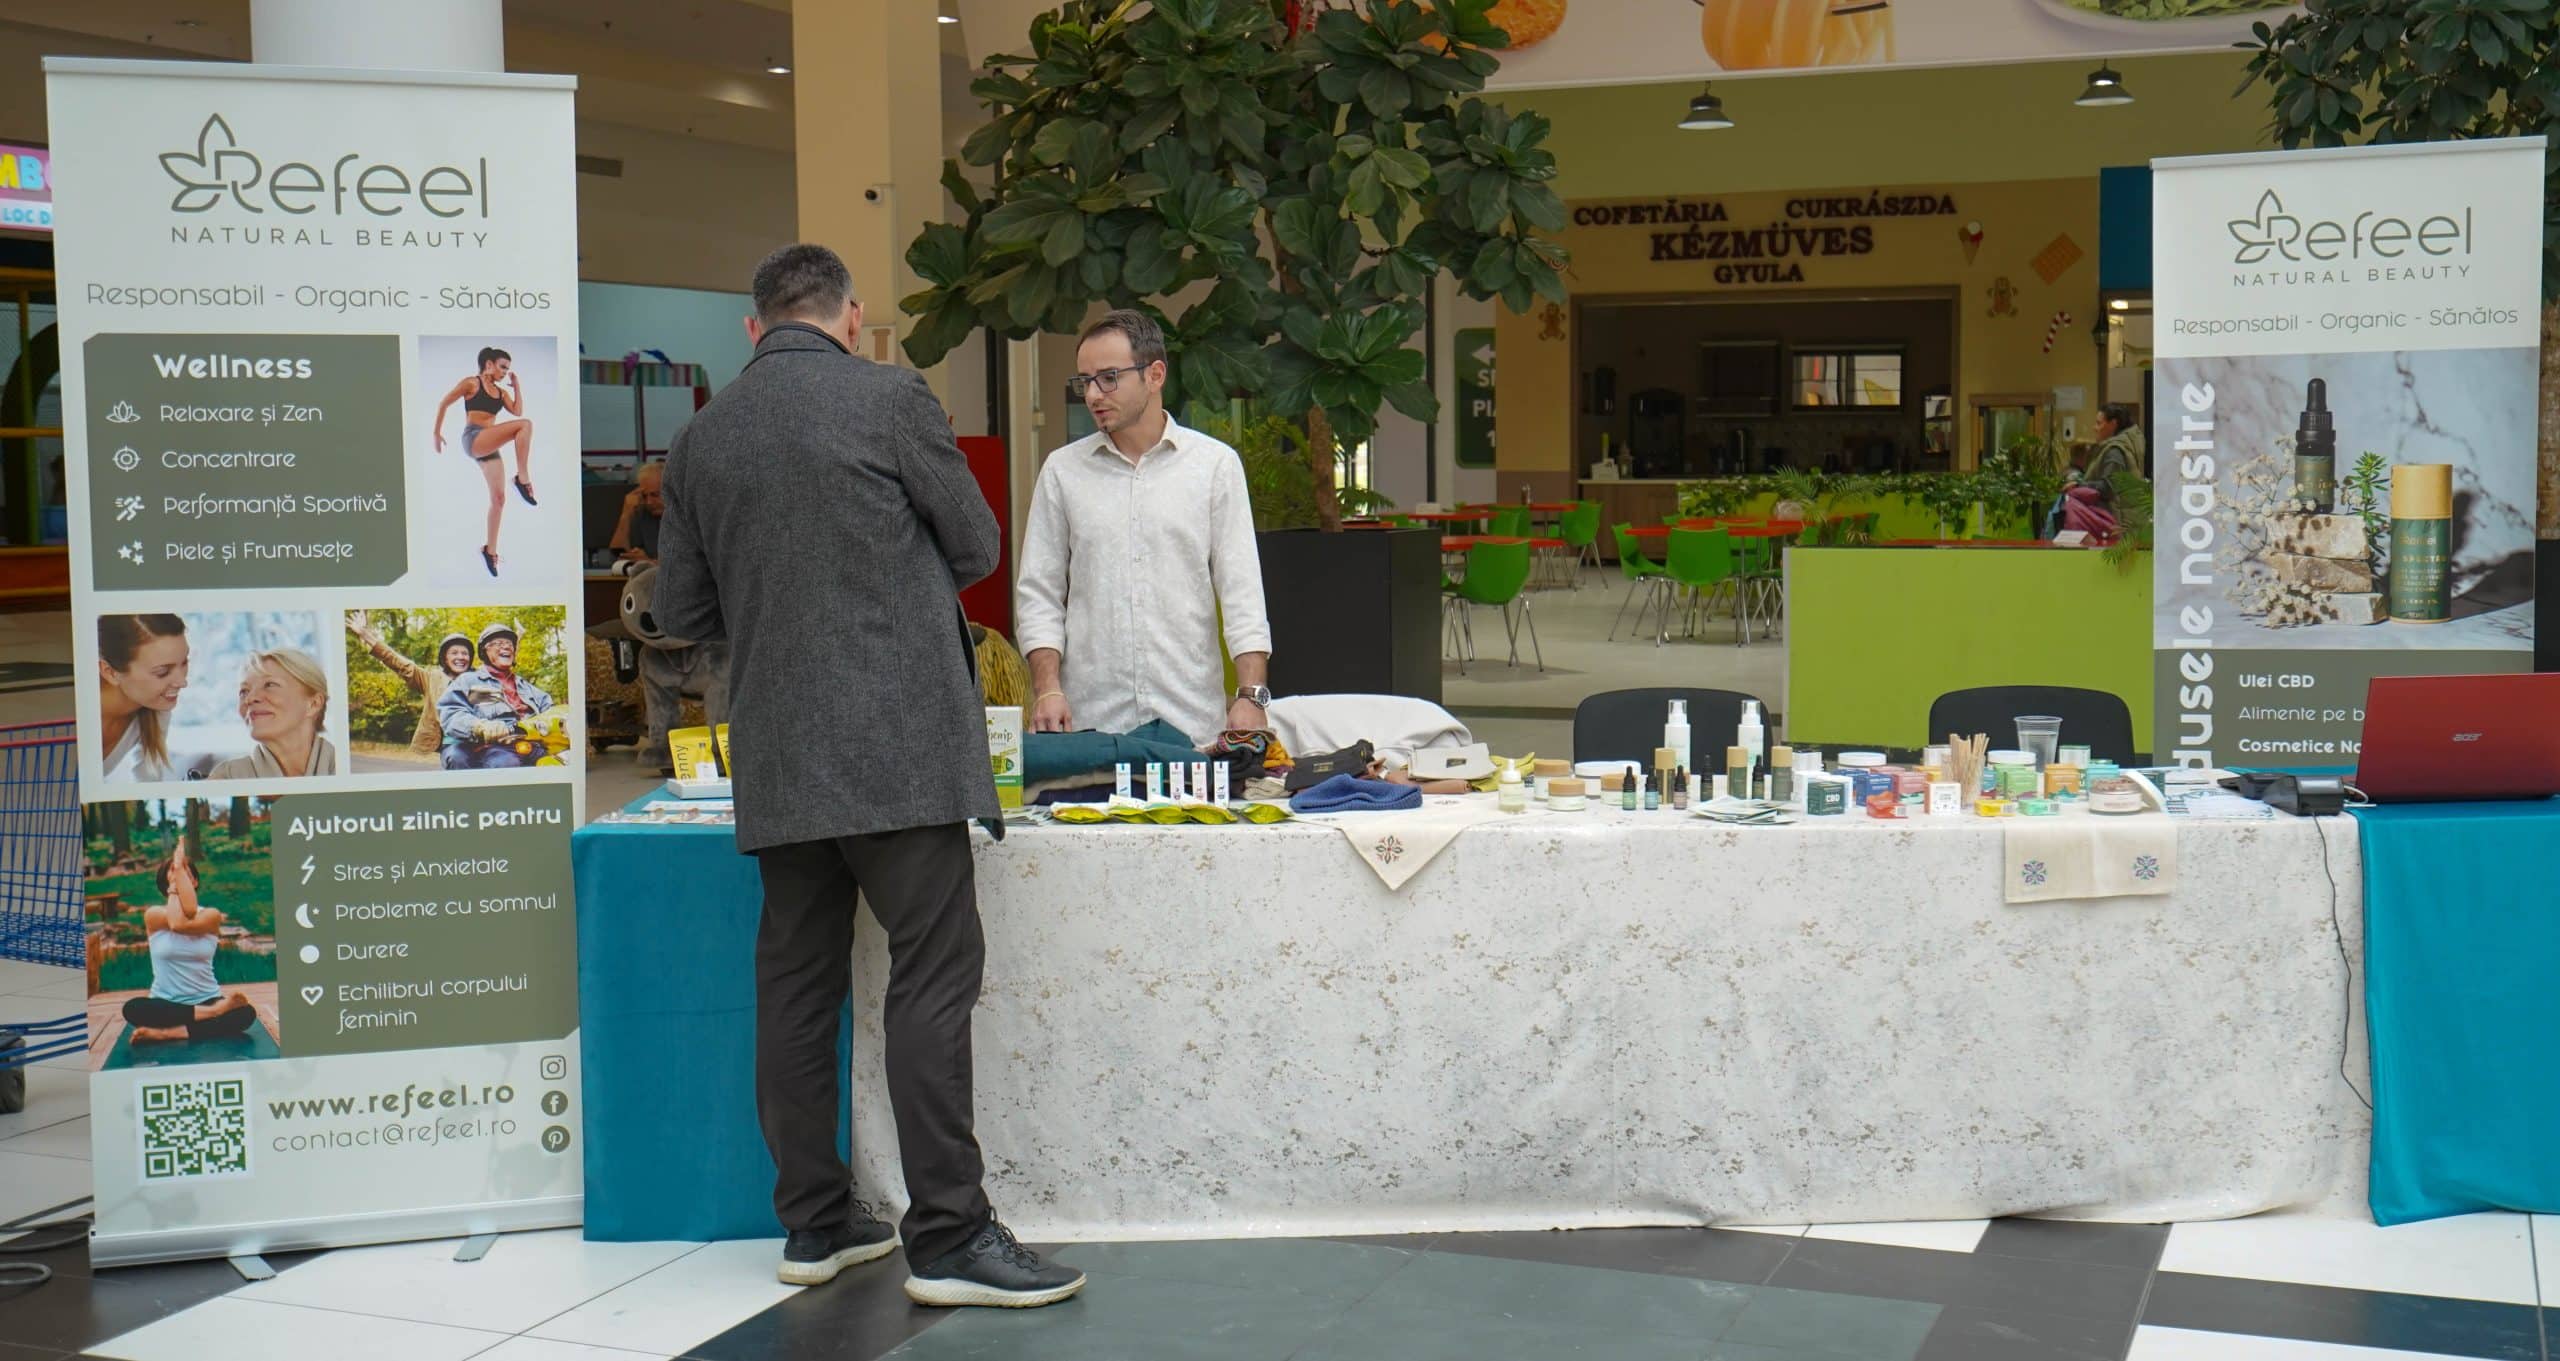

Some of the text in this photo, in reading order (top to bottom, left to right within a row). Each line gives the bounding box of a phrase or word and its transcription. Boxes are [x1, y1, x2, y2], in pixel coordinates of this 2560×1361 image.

[213, 149, 488, 219] Refeel
[3, 208, 34, 223] LOC
[1573, 191, 1957, 225] COFETĂRIA CUKRÁSZDA
[171, 226, 488, 249] NATURAL BEAUTY
[2265, 206, 2472, 262] Refeel
[1714, 265, 1804, 284] GYULA
[2233, 264, 2470, 287] NATURAL BEAUTY
[87, 283, 264, 309] Responsabil
[295, 285, 409, 314] Organic
[439, 285, 551, 310] Sănătos
[2174, 314, 2298, 337] Responsabil
[2320, 311, 2407, 334] Organic
[2429, 306, 2519, 327] Sănătos
[152, 354, 313, 379] Wellness
[160, 404, 323, 427] Relaxare și Zen
[1473, 400, 1496, 417] PI
[161, 450, 296, 469] Concentrare
[2172, 380, 2217, 586] noastre
[163, 492, 387, 520] Performanță Sportivă
[165, 540, 354, 565] Piele și Frumusețe
[2239, 674, 2315, 688] Ulei CBD
[2238, 706, 2316, 721] Alimente
[2322, 709, 2346, 723] pe
[2238, 738, 2335, 754] Cosmetice
[2452, 732, 2483, 742] acer
[287, 806, 561, 840] Ajutorul zilnic pentru
[333, 857, 509, 884] Stres și Anxietate
[335, 892, 556, 921] Probleme cu somnul
[337, 943, 409, 961] Durere
[338, 973, 528, 1002] Echilibrul corpului
[335, 1008, 417, 1035] feminin
[268, 1083, 515, 1121] www.refeel.ro
[272, 1116, 517, 1153] contact@refeel.ro
